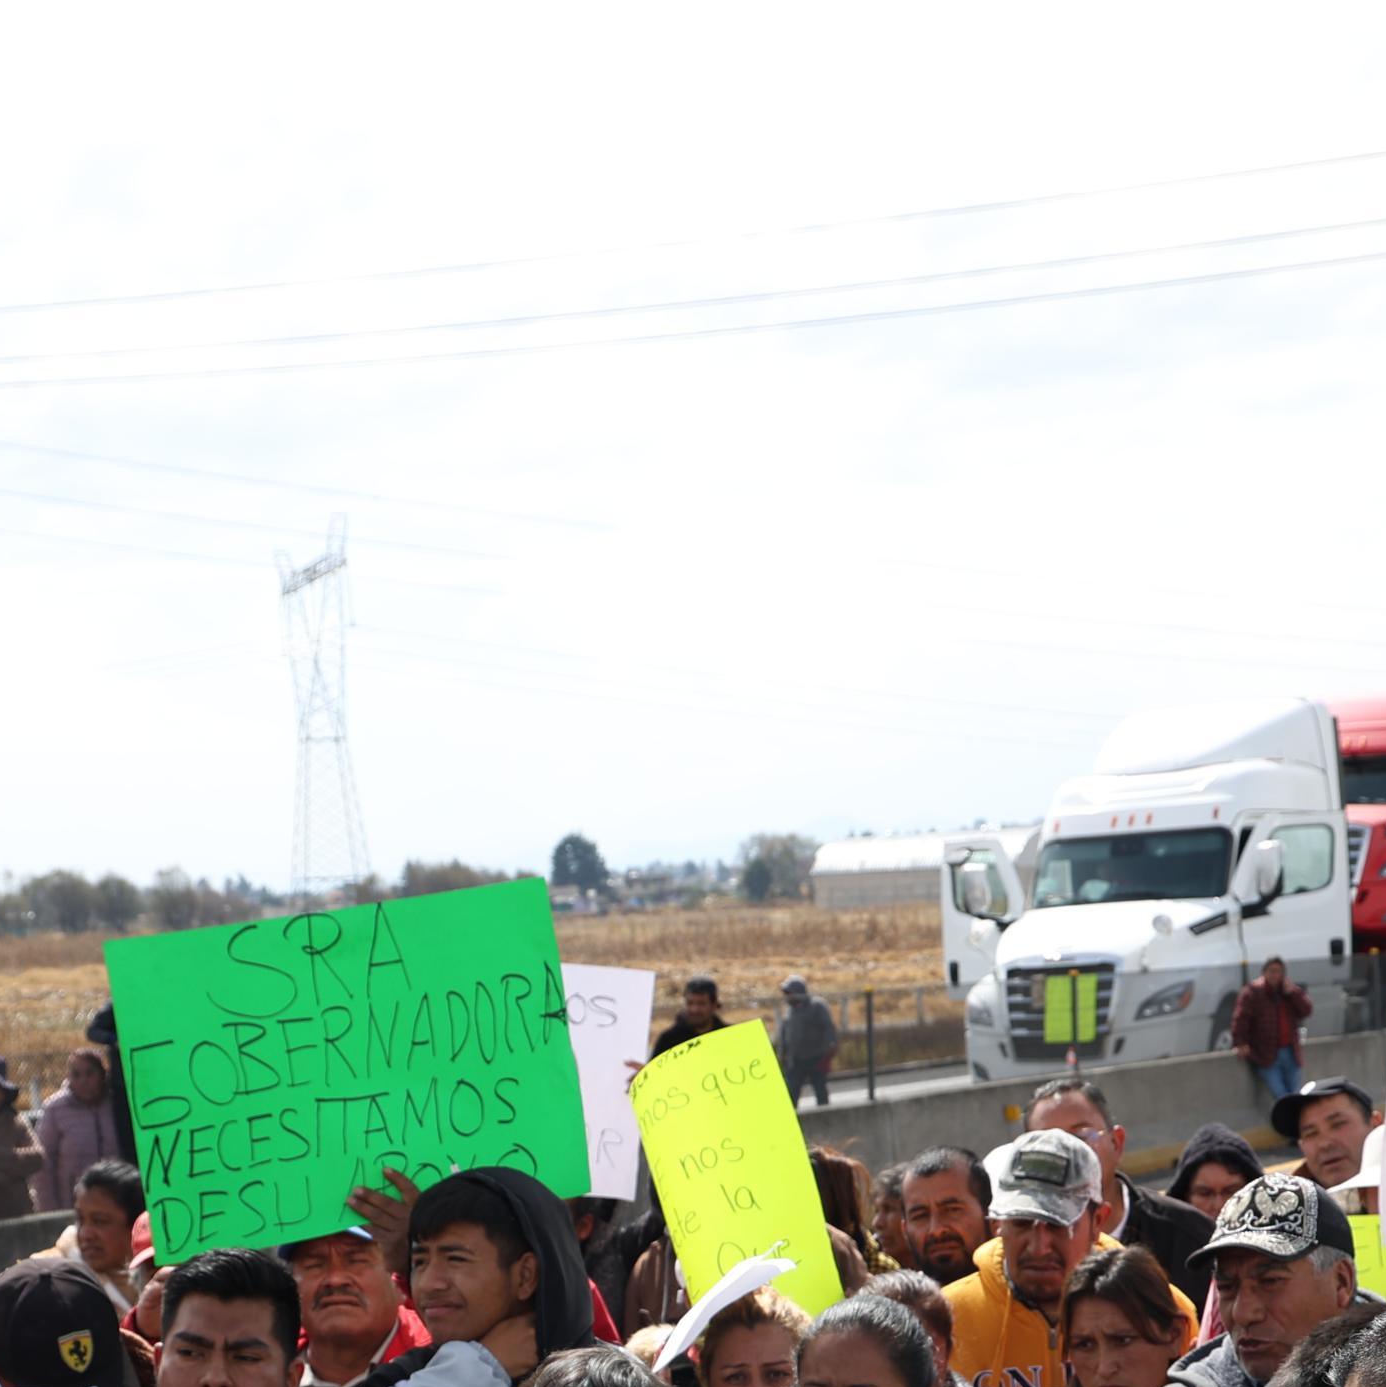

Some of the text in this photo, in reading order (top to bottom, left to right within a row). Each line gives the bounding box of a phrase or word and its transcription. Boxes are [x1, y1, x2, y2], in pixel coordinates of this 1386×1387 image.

[205, 901, 413, 1019] SRA
[128, 960, 569, 1130] GOBERNADORA
[701, 1057, 767, 1107] que
[145, 1076, 520, 1194] NECESITAMOS
[679, 1137, 745, 1180] nos
[720, 1183, 763, 1214] la
